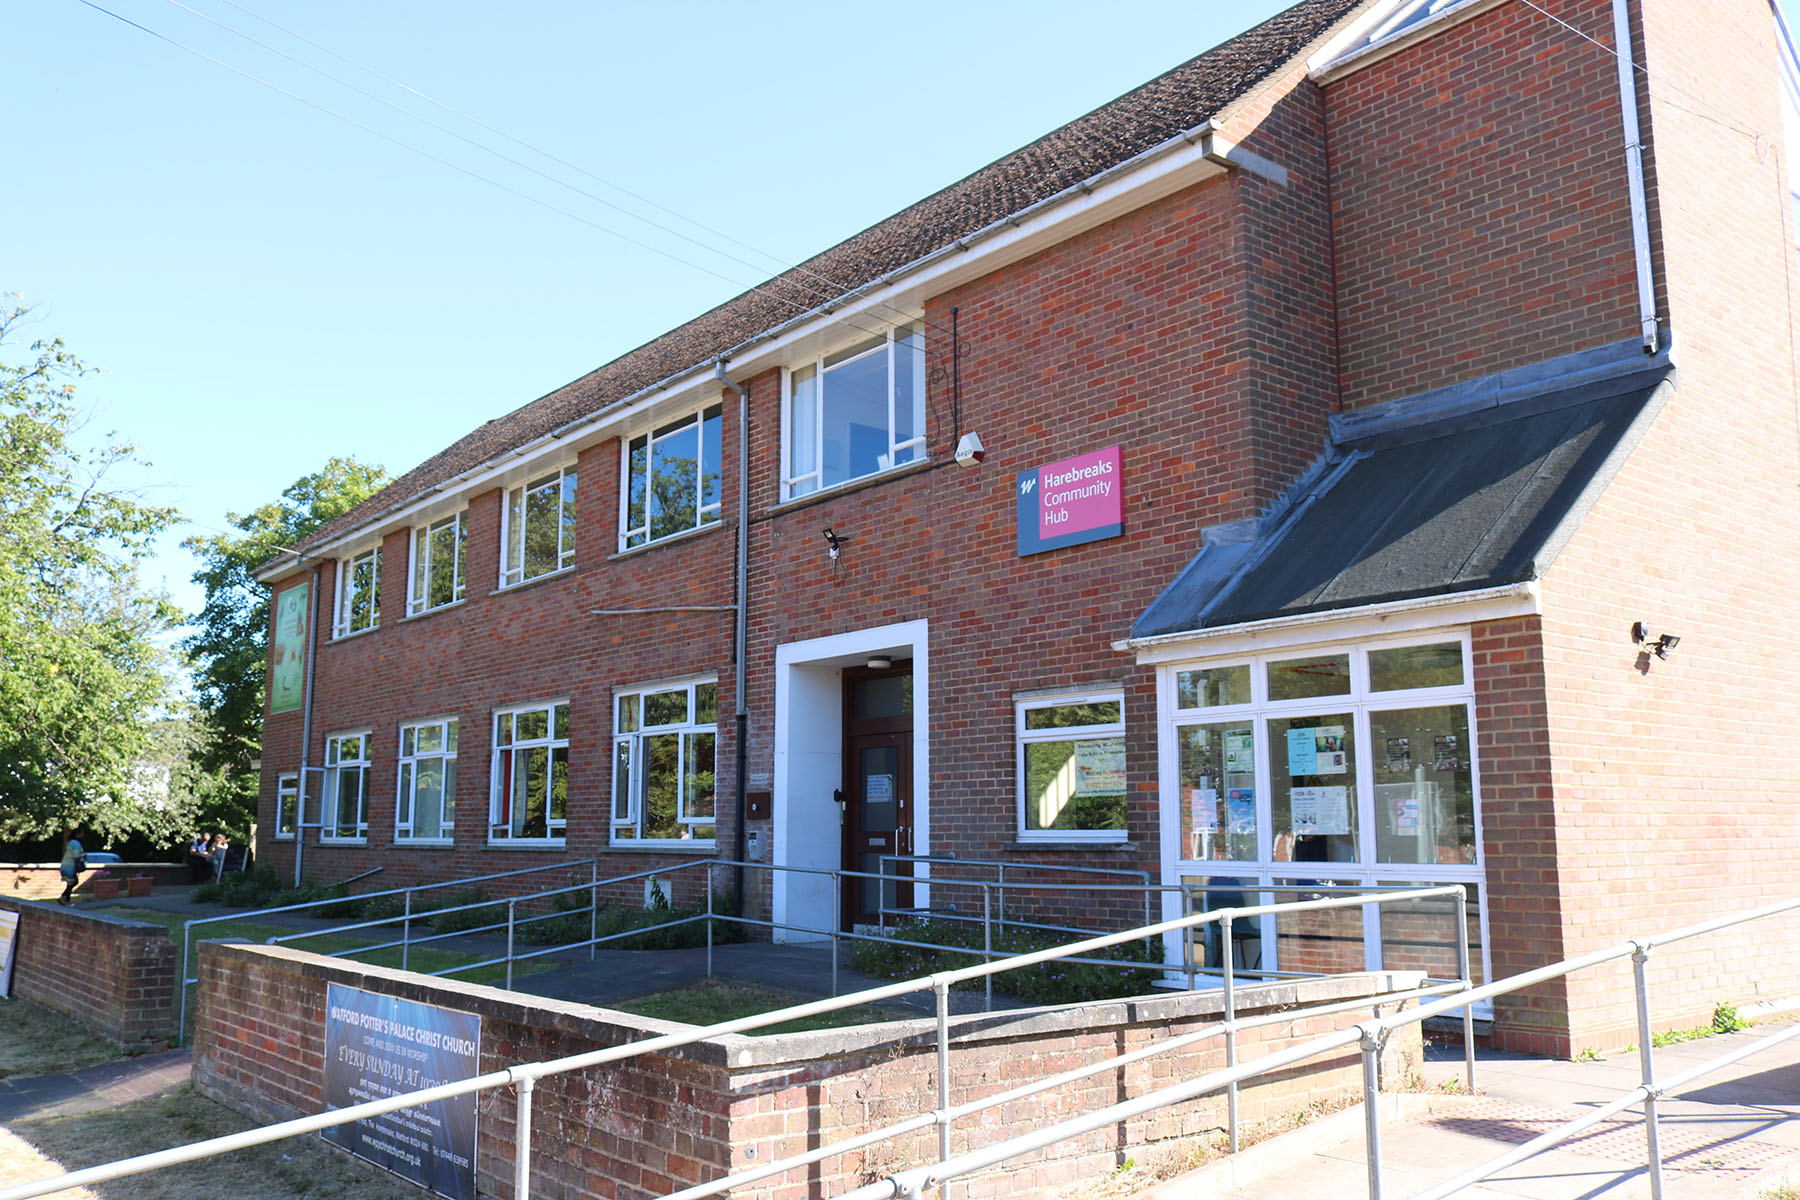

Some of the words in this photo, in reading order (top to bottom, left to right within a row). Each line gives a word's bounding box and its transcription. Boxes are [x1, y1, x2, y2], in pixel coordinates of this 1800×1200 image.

[1044, 459, 1113, 489] Harebreaks
[1044, 480, 1112, 507] Community
[1045, 507, 1069, 526] Hub
[331, 1006, 359, 1025] WATFORD
[360, 1013, 389, 1034] POTTER'S
[389, 1021, 415, 1041] PALACE
[416, 1028, 441, 1048] CHRIST
[442, 1035, 475, 1057] CHURCH
[338, 1044, 366, 1072] EVERY
[365, 1054, 404, 1085] SUNDAY
[404, 1068, 420, 1087] AT
[407, 1048, 428, 1063] WORSHIP
